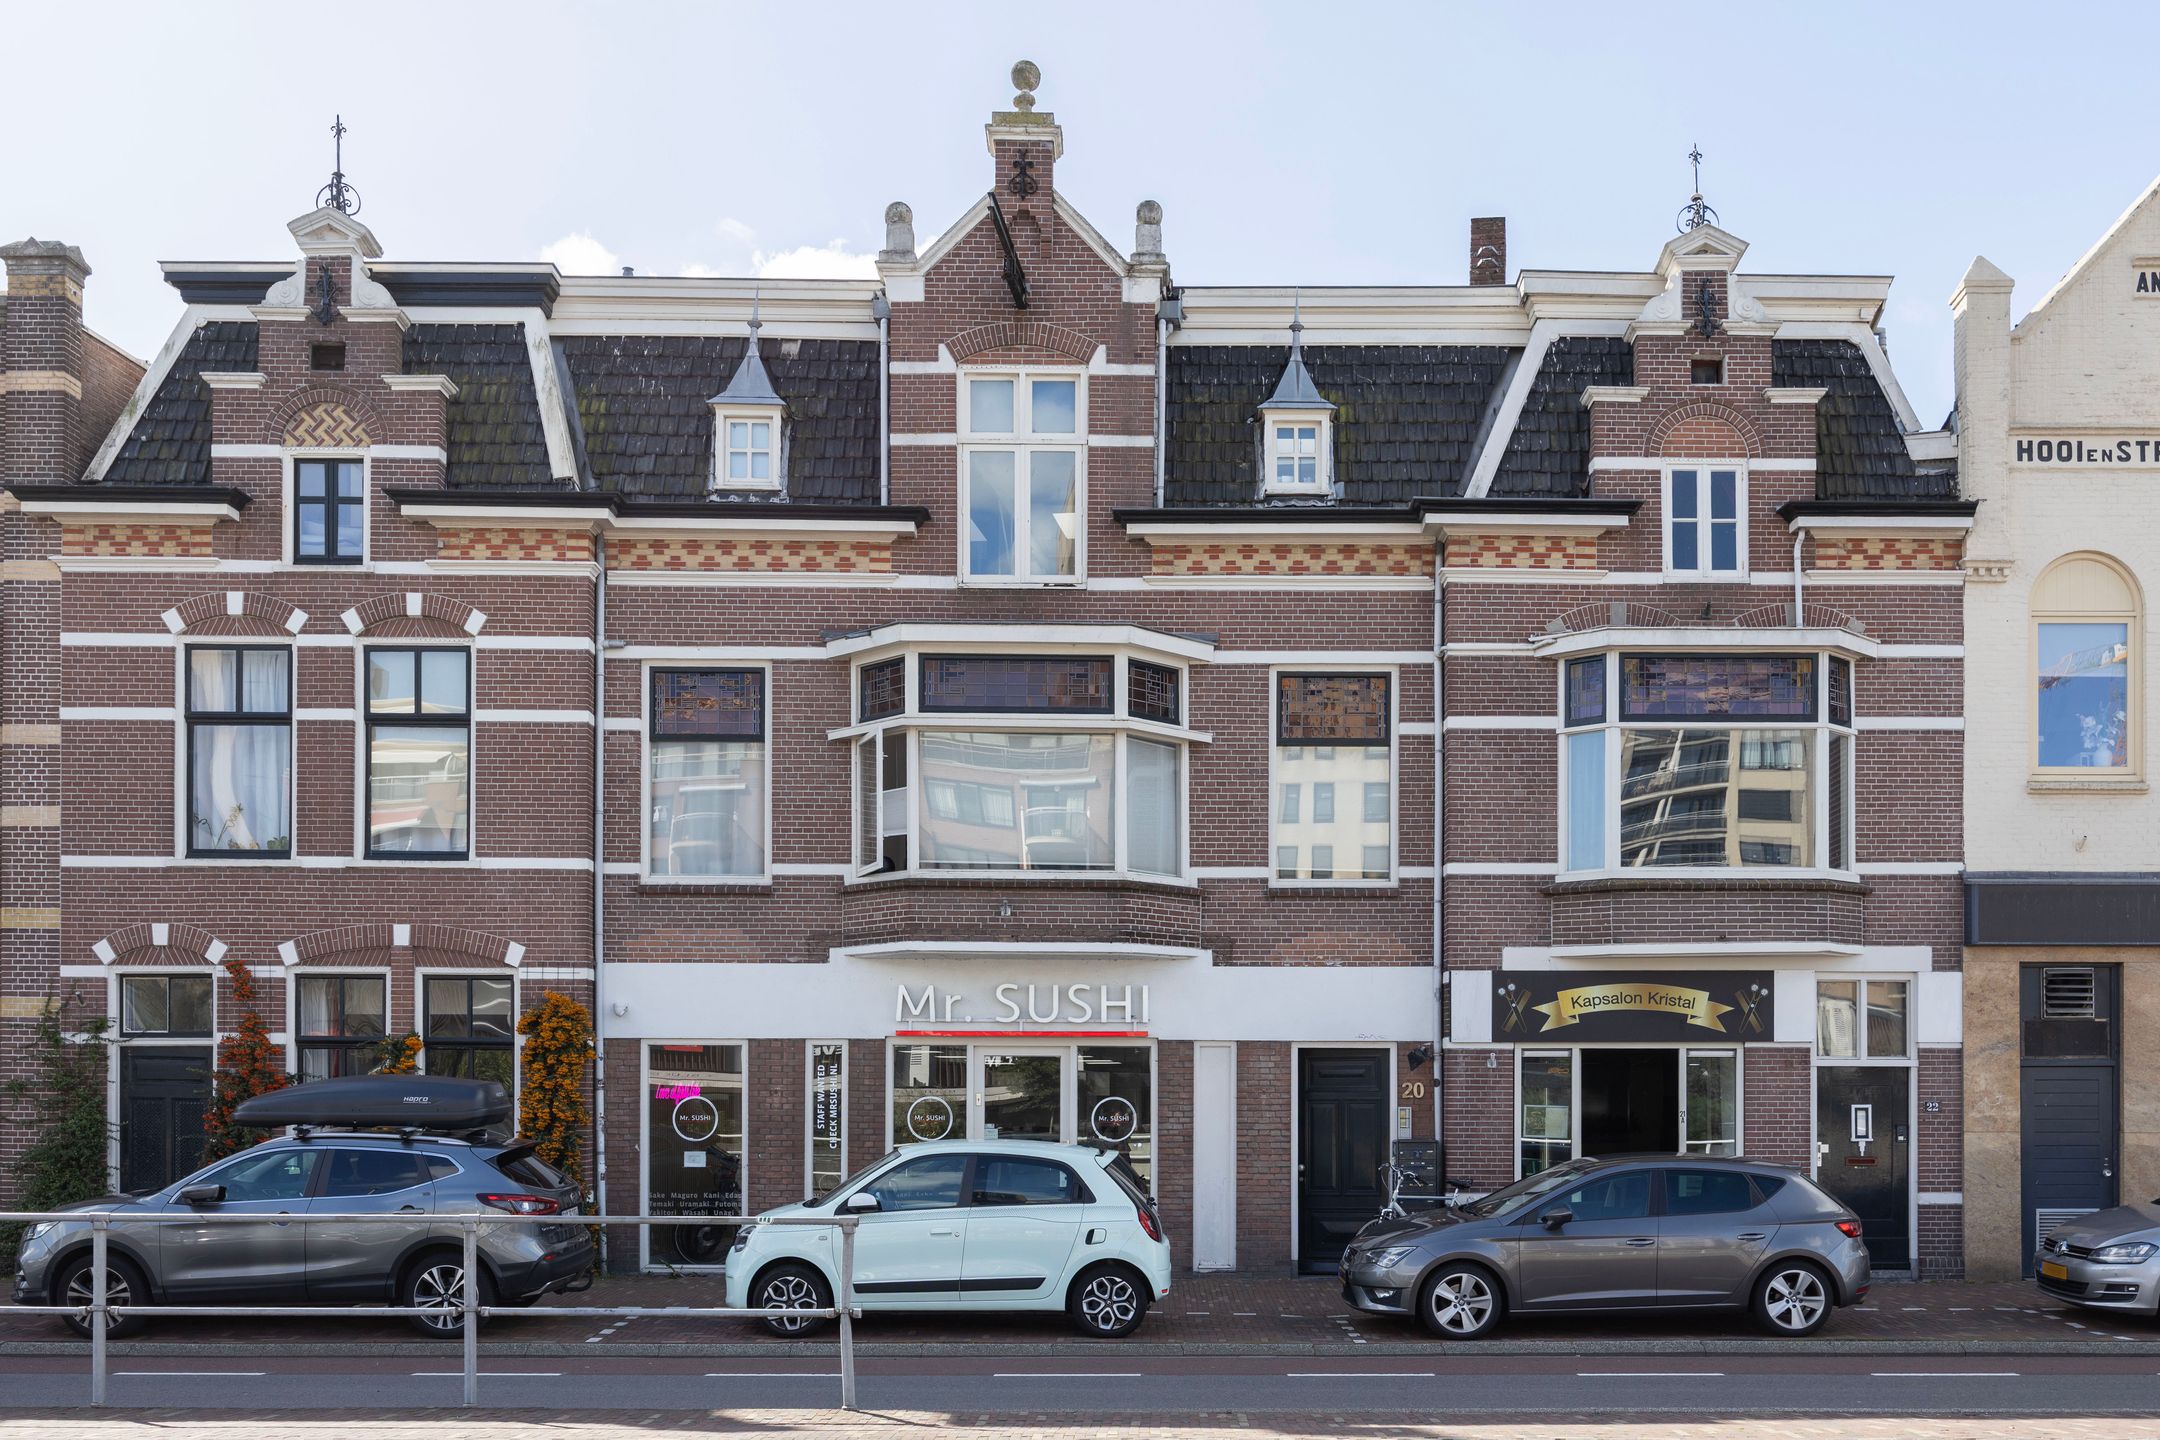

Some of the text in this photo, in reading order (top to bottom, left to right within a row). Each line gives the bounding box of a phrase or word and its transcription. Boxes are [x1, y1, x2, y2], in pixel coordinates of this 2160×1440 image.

[896, 983, 1149, 1023] Mr. SUSHI
[1571, 991, 1696, 1010] Kapsalon Kristal
[817, 1064, 825, 1129] STAFF WANTED
[1401, 1082, 1425, 1099] 20
[1679, 1110, 1686, 1118] 21
[1926, 1102, 1939, 1112] 22
[829, 1119, 838, 1149] CHECK
[670, 1192, 698, 1200] Maguro
